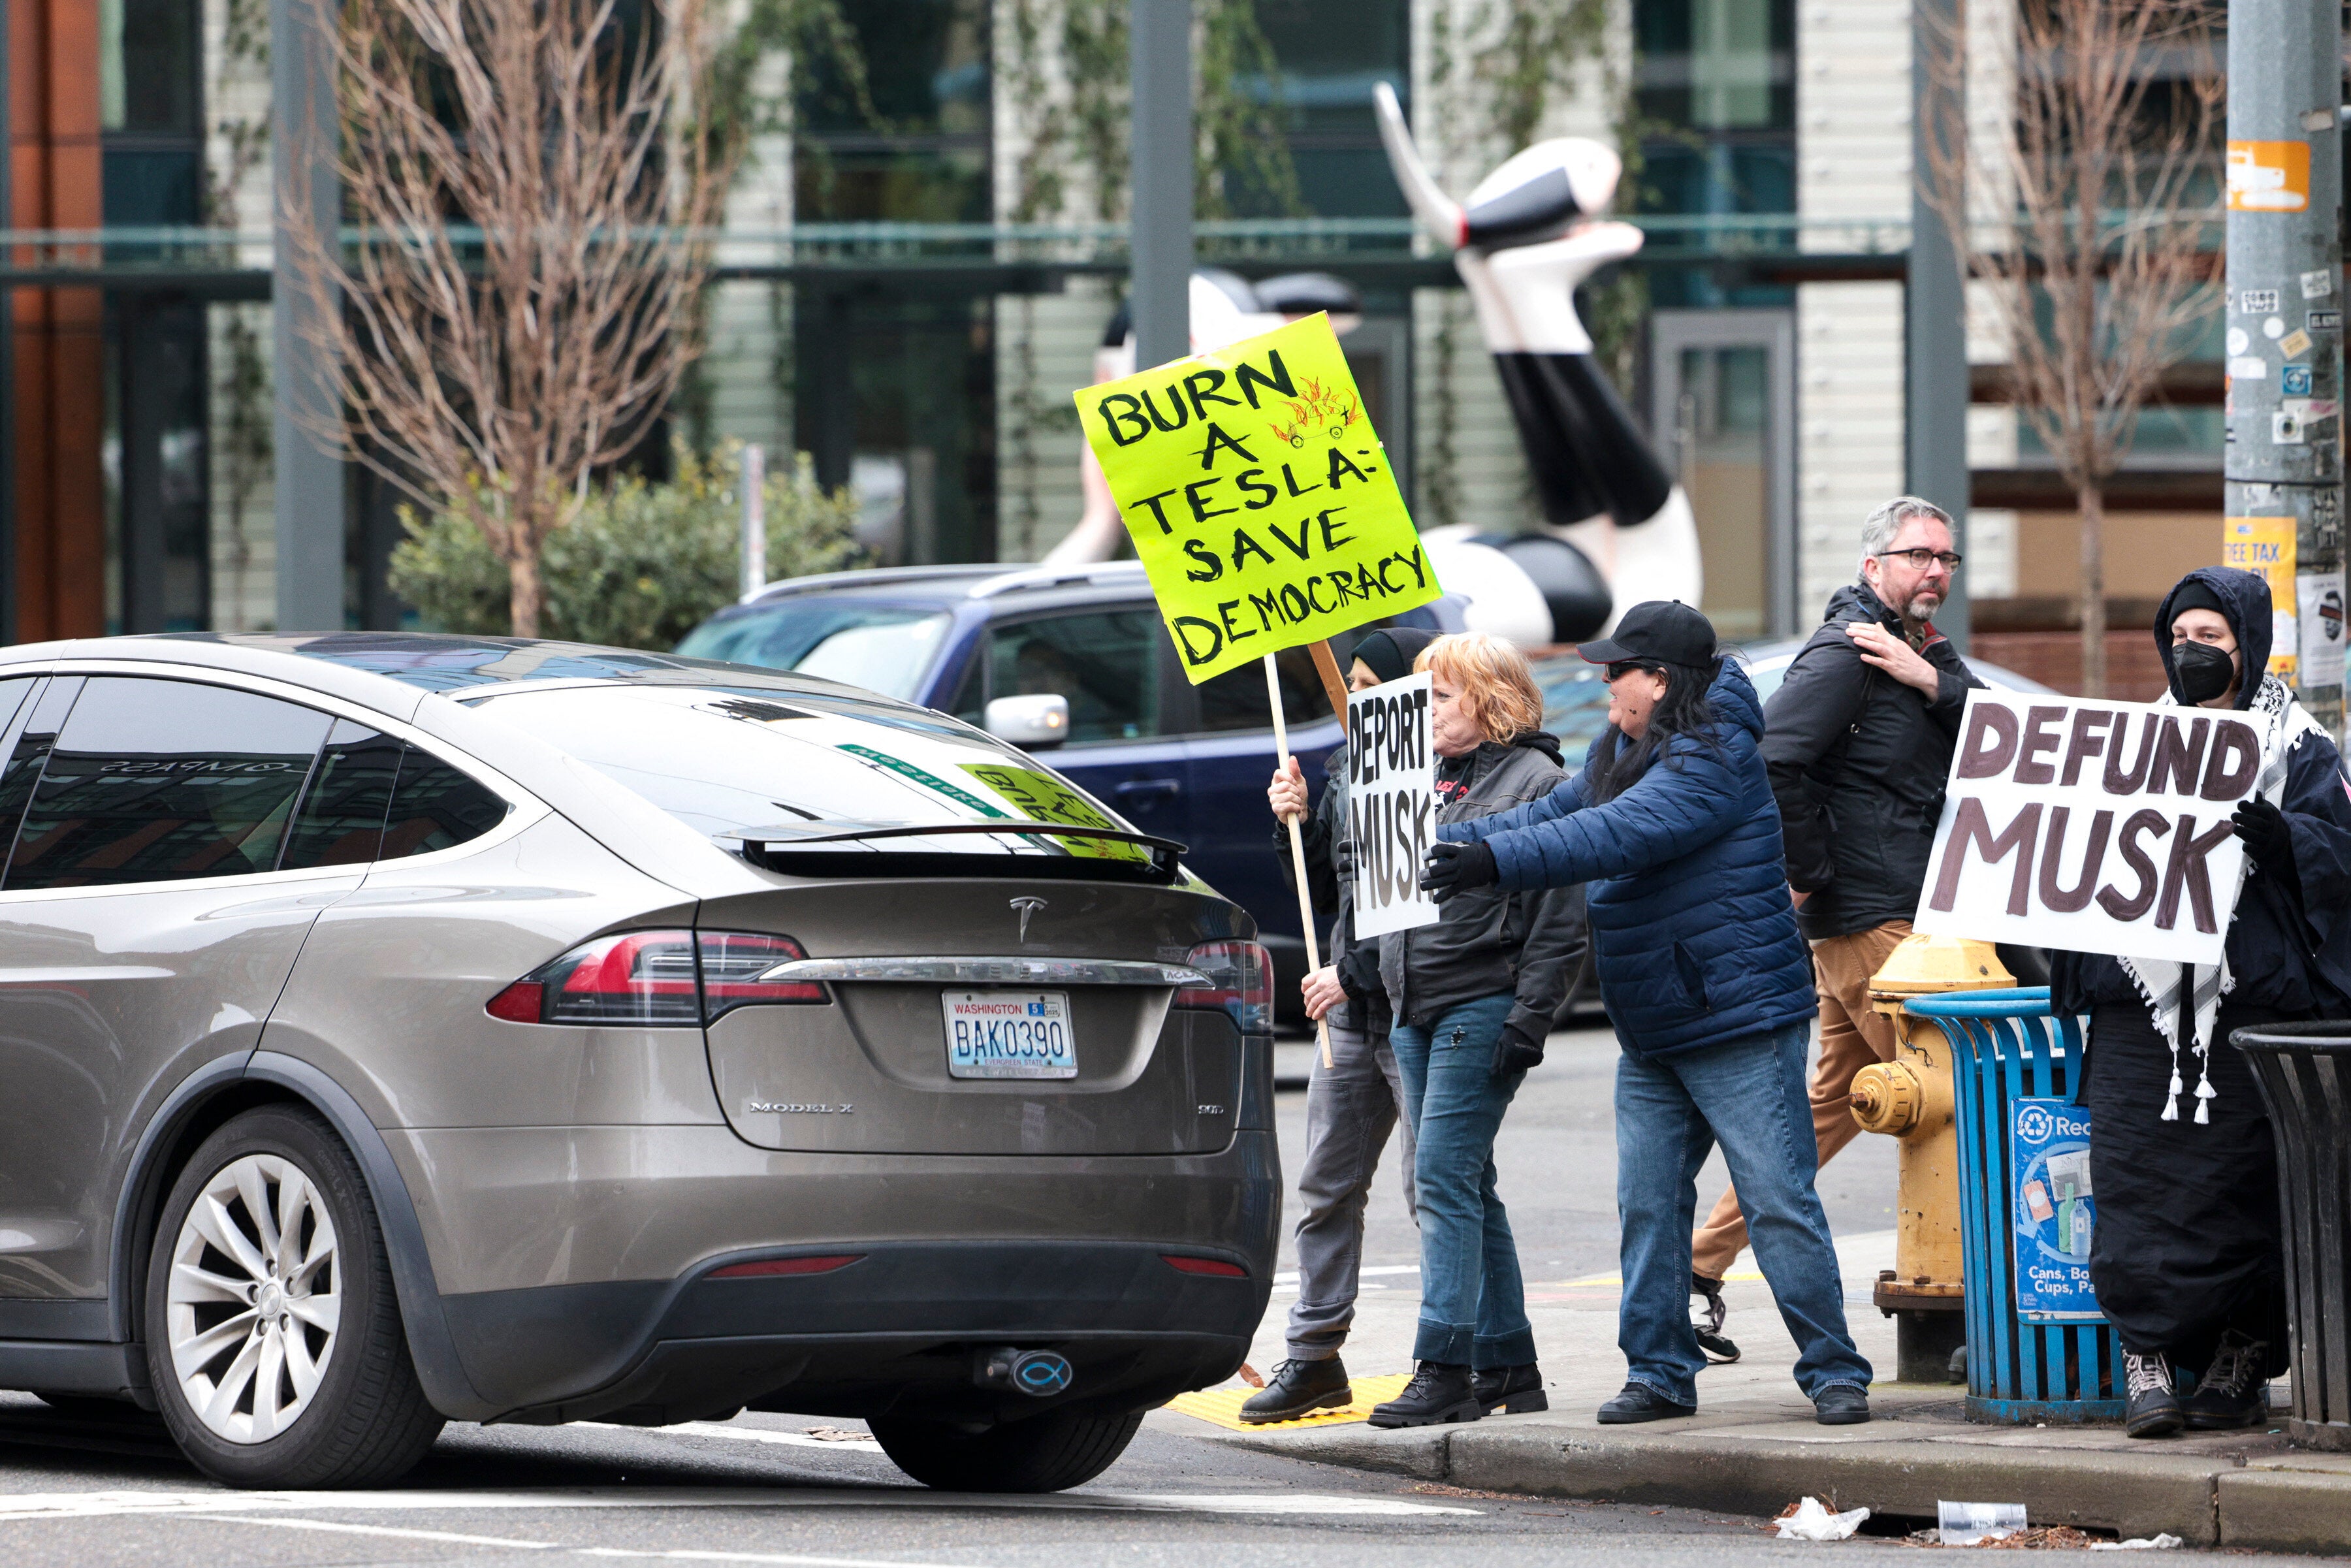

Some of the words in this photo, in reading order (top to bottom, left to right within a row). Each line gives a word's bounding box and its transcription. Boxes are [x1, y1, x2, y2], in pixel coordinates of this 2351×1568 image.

[1099, 349, 1298, 447] BURN
[1189, 422, 1259, 470] A
[1183, 506, 1358, 582] SAVE
[2252, 543, 2280, 562] TAX
[1172, 544, 1426, 666] DEMOCRACY
[1349, 688, 1428, 785] DEPORT
[1956, 702, 2260, 801] DEFUND
[1351, 788, 1434, 913] MUSK
[1928, 797, 2237, 935] MUSK
[954, 1004, 1022, 1015] WASHINGTON
[1032, 1004, 1038, 1014] 5
[955, 1020, 1064, 1057] BAK0390
[750, 1102, 833, 1113] MODEL
[839, 1103, 854, 1114] X
[1198, 1104, 1224, 1114] 90D
[2028, 1265, 2065, 1281] Cans,
[2034, 1280, 2073, 1296] Cups,
